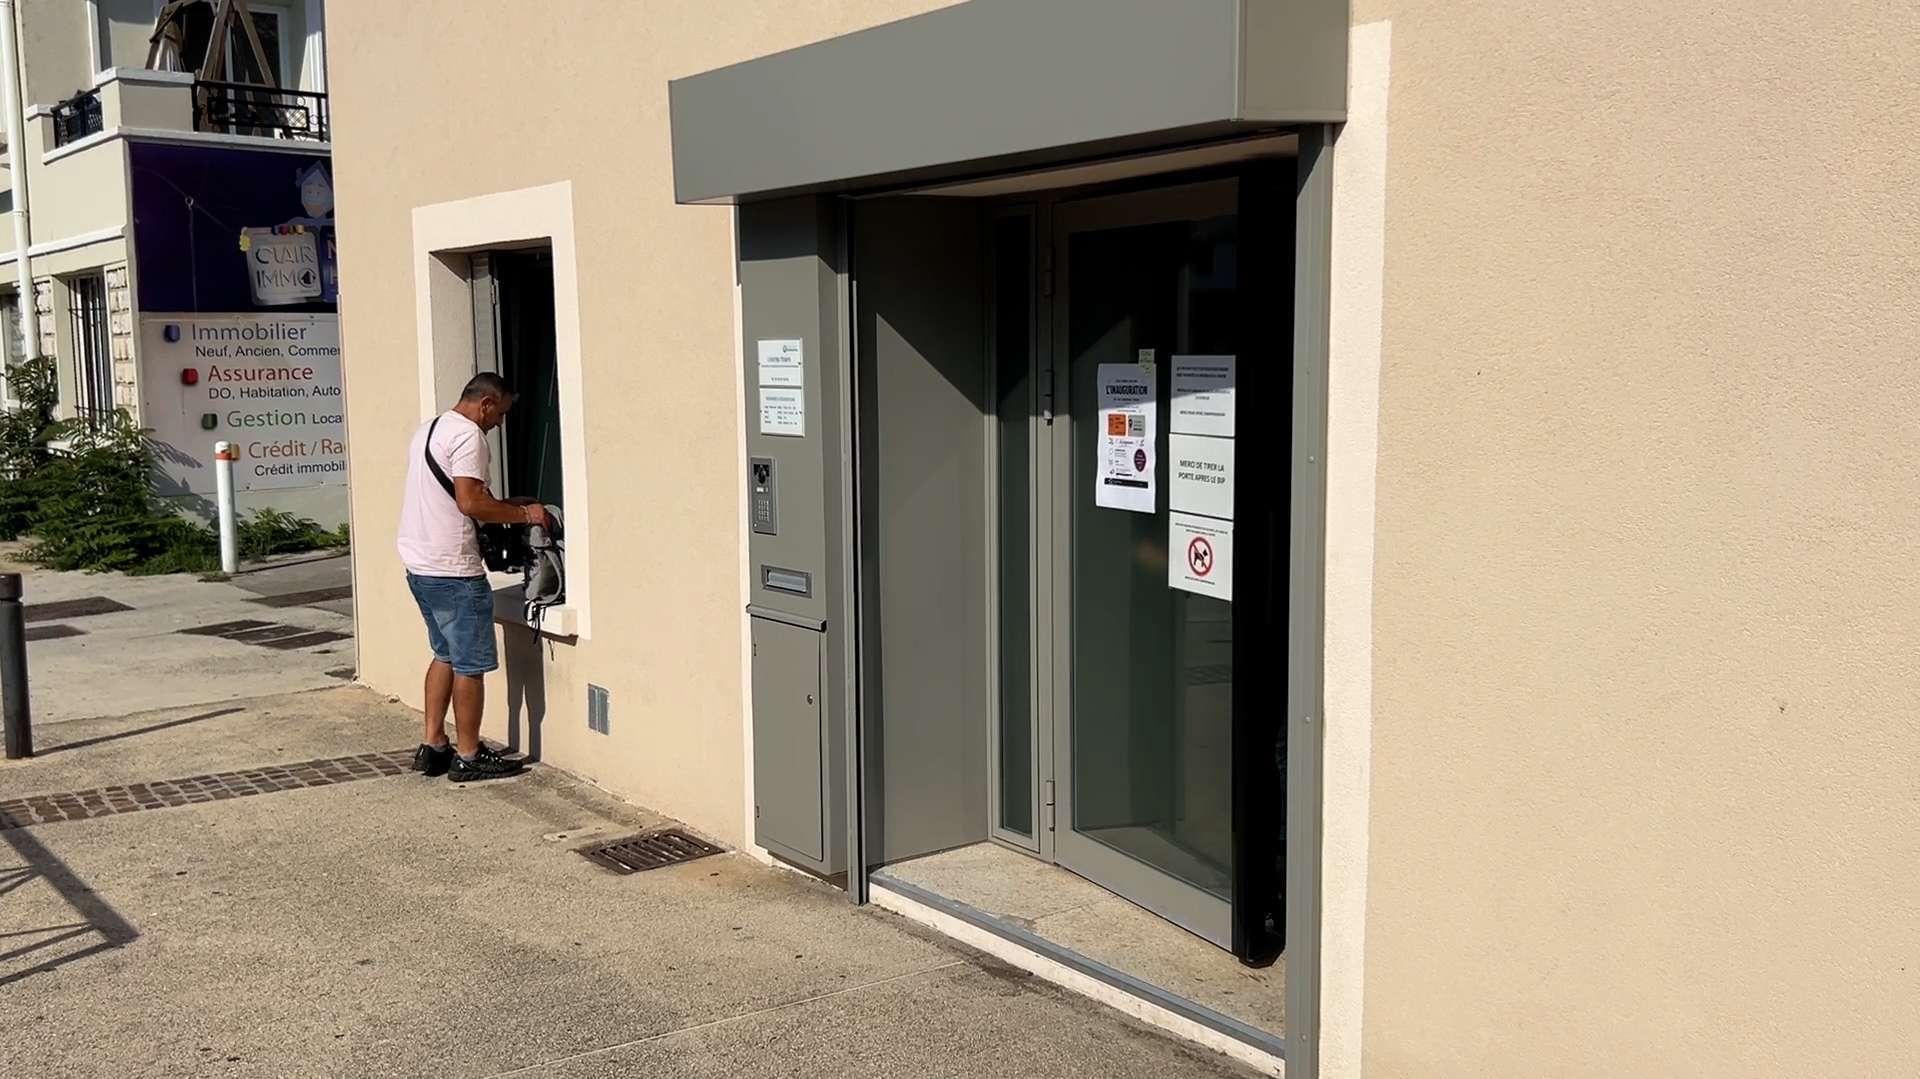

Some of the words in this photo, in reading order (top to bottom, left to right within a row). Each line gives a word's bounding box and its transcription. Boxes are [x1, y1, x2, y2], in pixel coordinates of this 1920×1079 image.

[255, 245, 314, 264] CLAIR
[192, 323, 307, 341] Immobilier
[195, 345, 232, 359] Neuf,
[235, 345, 285, 358] Ancien,
[208, 364, 314, 383] Assurance
[208, 387, 236, 401] DO,
[240, 386, 310, 399] Habitation,
[312, 385, 342, 397] Auto
[227, 409, 306, 428] Gestion
[248, 440, 307, 459] Crédit
[254, 463, 294, 477] Crédit
